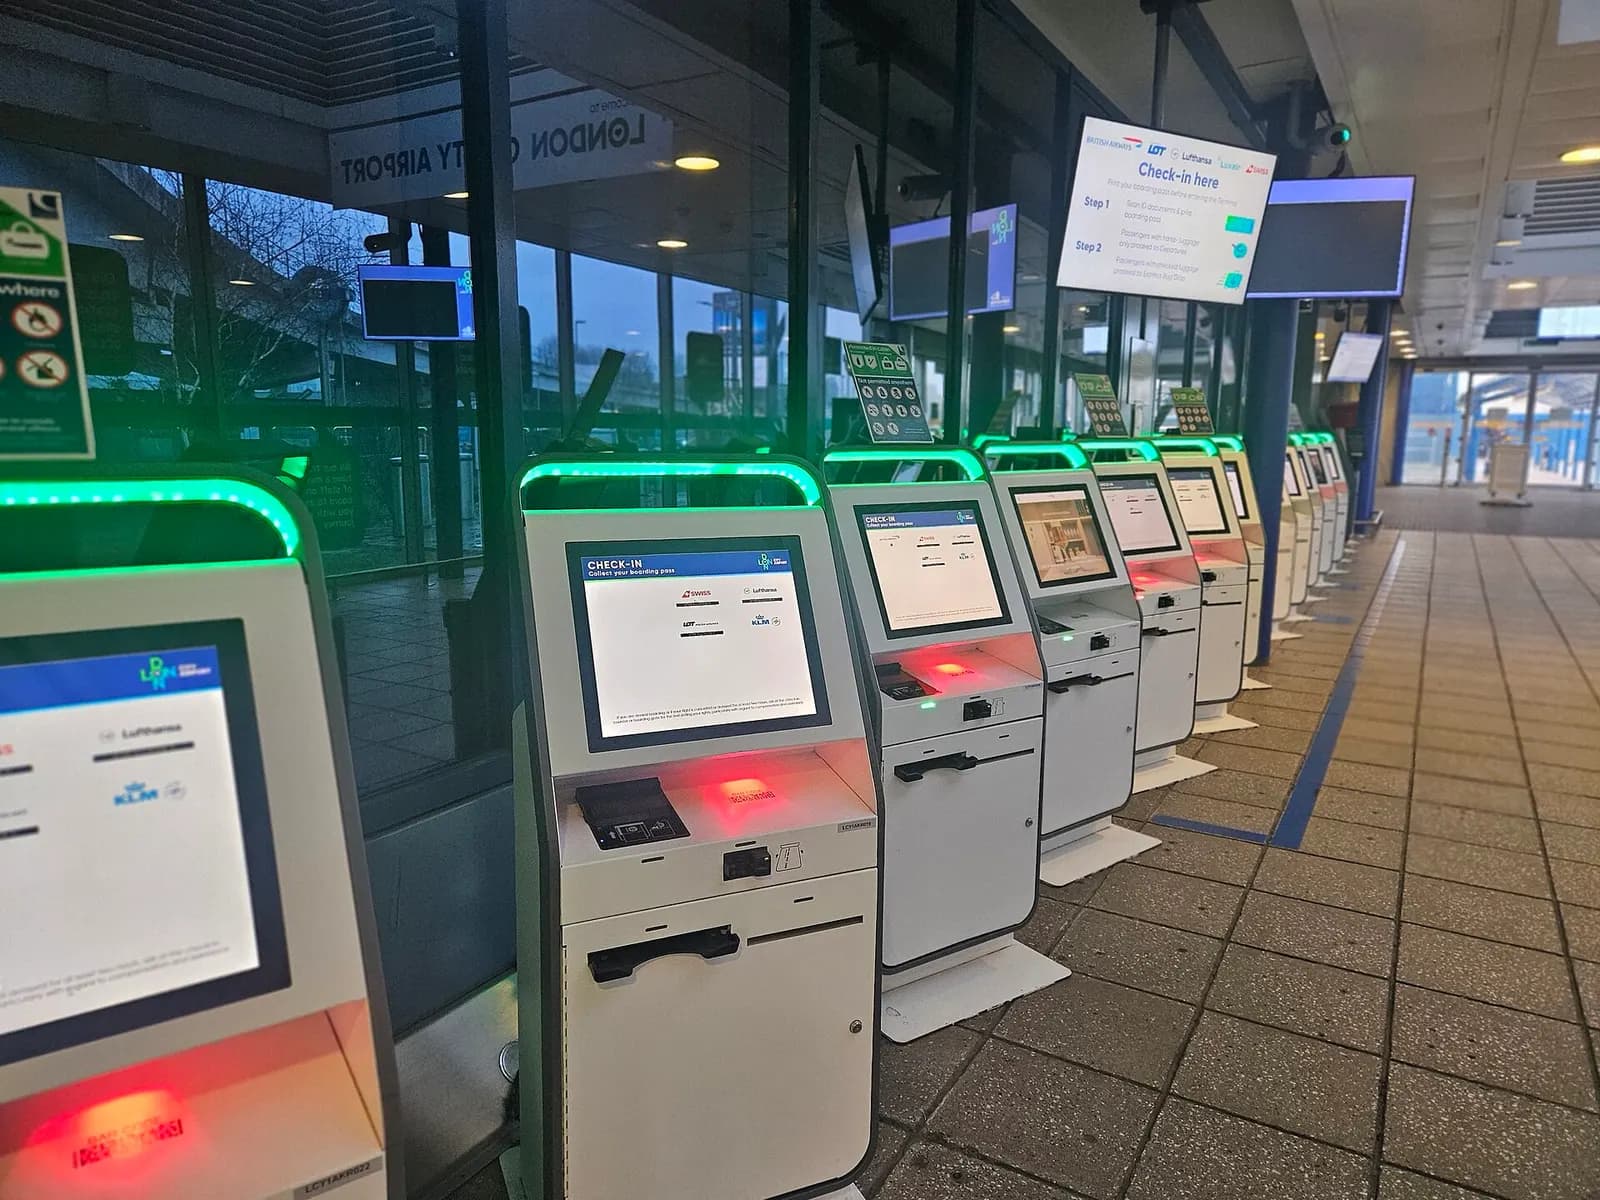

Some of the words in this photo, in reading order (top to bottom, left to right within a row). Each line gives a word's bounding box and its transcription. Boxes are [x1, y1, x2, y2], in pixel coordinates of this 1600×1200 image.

[1147, 144, 1167, 156] LOT
[1182, 152, 1212, 165] Lufthansa
[1138, 161, 1191, 185] Check-in
[1193, 172, 1219, 189] here
[1084, 196, 1104, 209] Step
[1105, 200, 1110, 209] 1
[1075, 241, 1095, 253] Step
[1096, 243, 1102, 252] 2
[587, 559, 642, 570] CHECK-IN
[121, 724, 183, 740] Lufthansa
[113, 789, 159, 806] KLM
